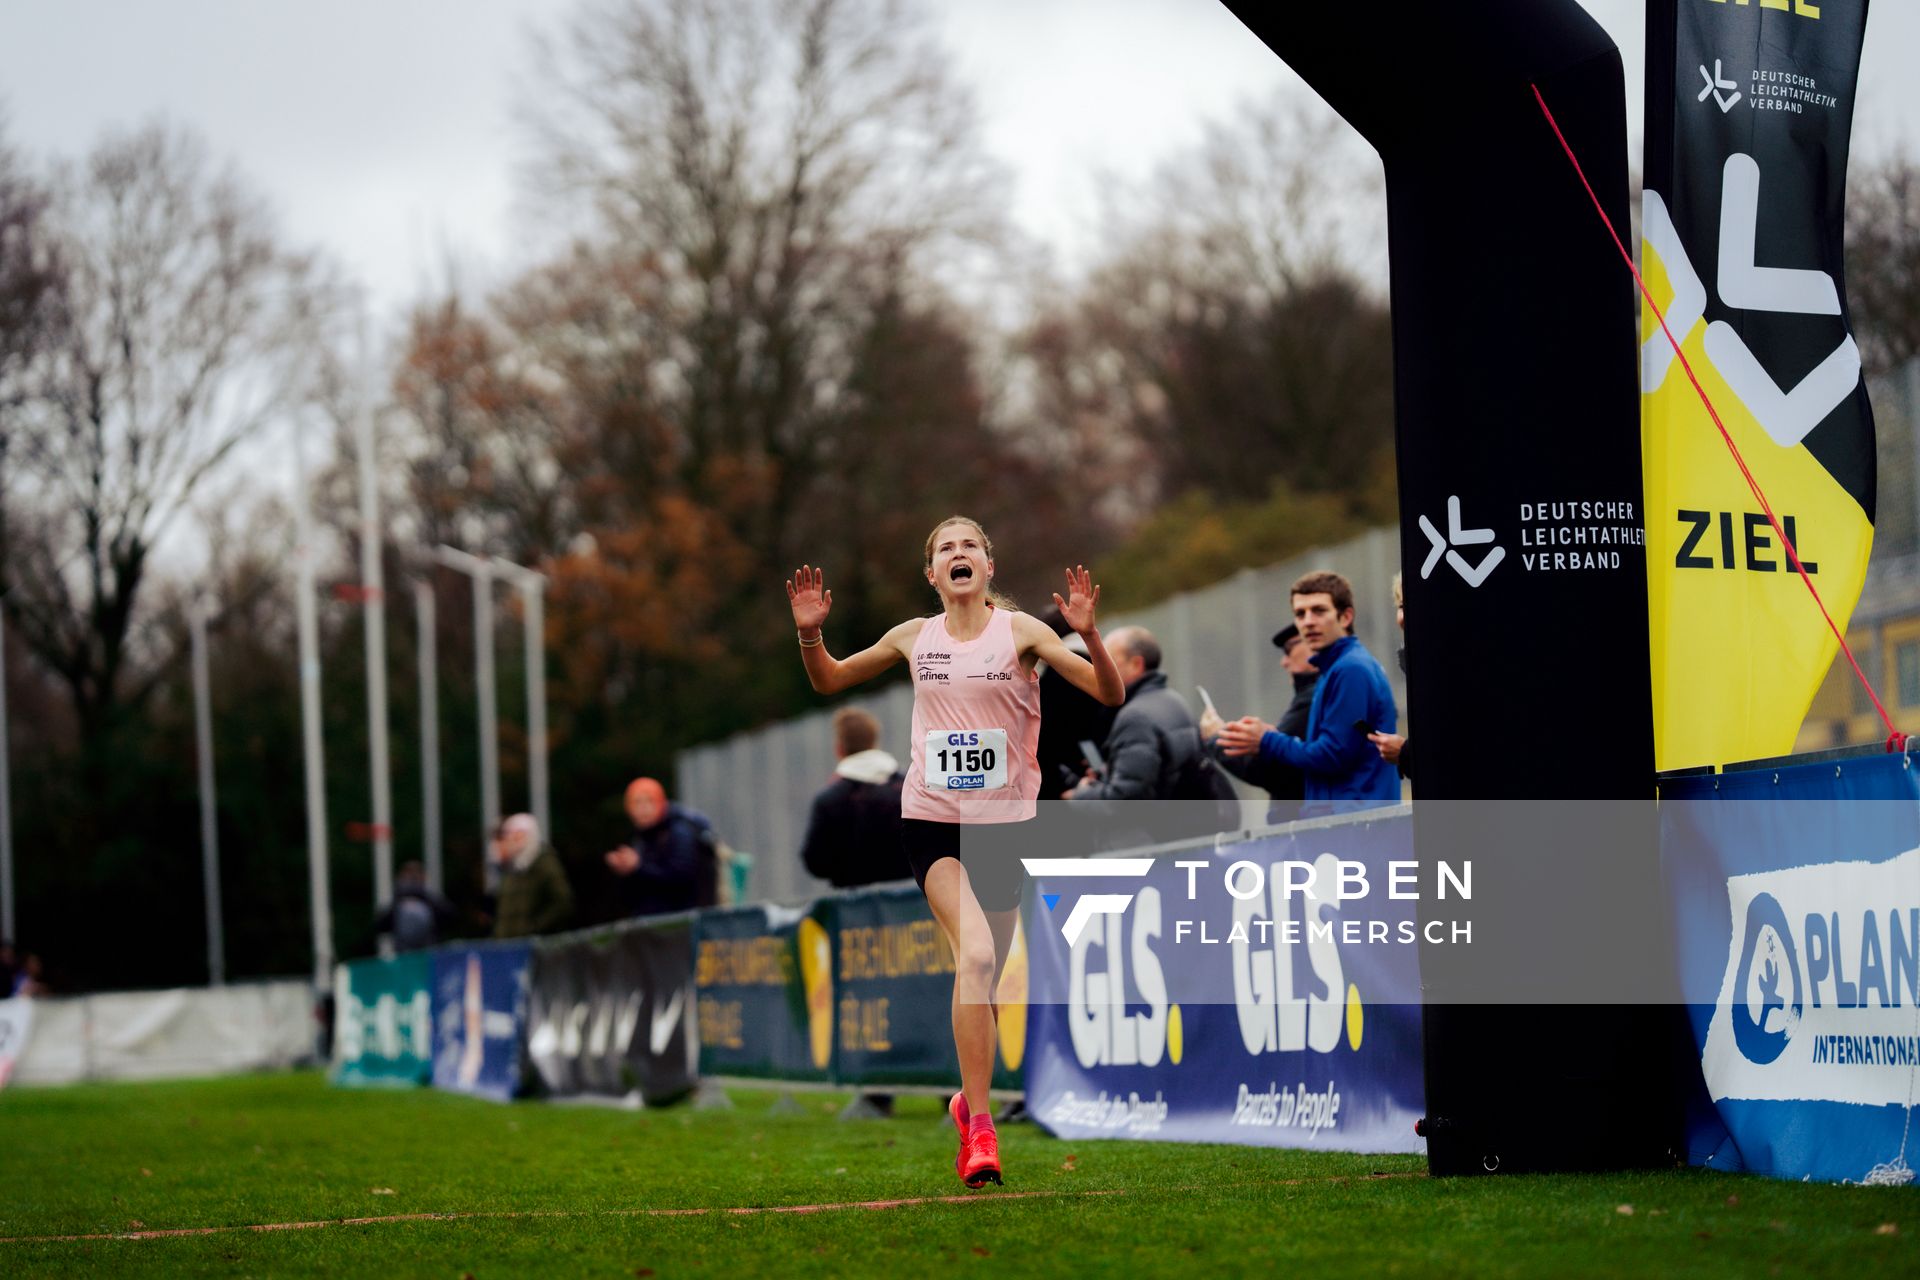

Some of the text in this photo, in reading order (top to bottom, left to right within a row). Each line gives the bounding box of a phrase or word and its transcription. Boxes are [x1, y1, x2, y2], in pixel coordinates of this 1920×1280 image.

[1752, 70, 1816, 89] DEUTSCHER
[1750, 98, 1803, 114] VERBAND
[1751, 84, 1837, 108] LEICHTATHLETIK
[1520, 501, 1634, 521] DEUTSCHER
[1675, 509, 1819, 574] ZIEL
[1522, 551, 1620, 571] VERBAND
[919, 671, 949, 681] infinex
[986, 672, 1012, 681] EnBW
[938, 749, 995, 771] 1150
[1804, 908, 1920, 1008] PLAN
[1231, 1081, 1340, 1141] Parcels to People
